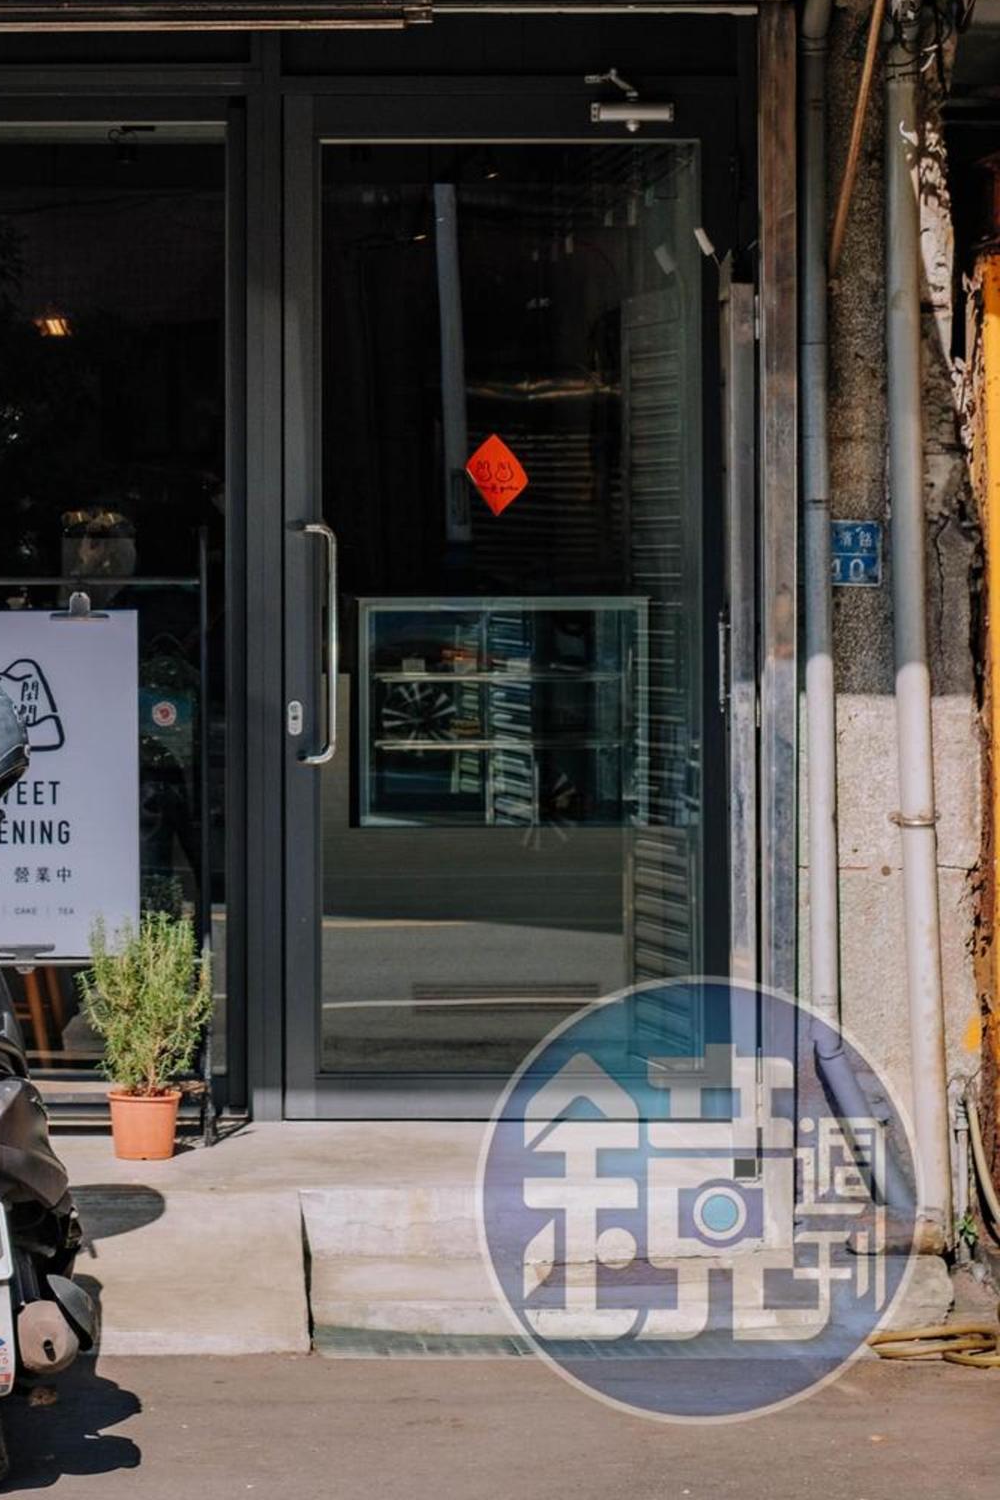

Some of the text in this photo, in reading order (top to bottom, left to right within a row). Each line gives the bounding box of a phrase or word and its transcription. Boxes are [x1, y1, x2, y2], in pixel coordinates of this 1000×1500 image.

[2, 780, 61, 805] EET
[14, 866, 72, 884] 營業中
[14, 906, 38, 916] CAKE
[57, 906, 75, 916] TEA
